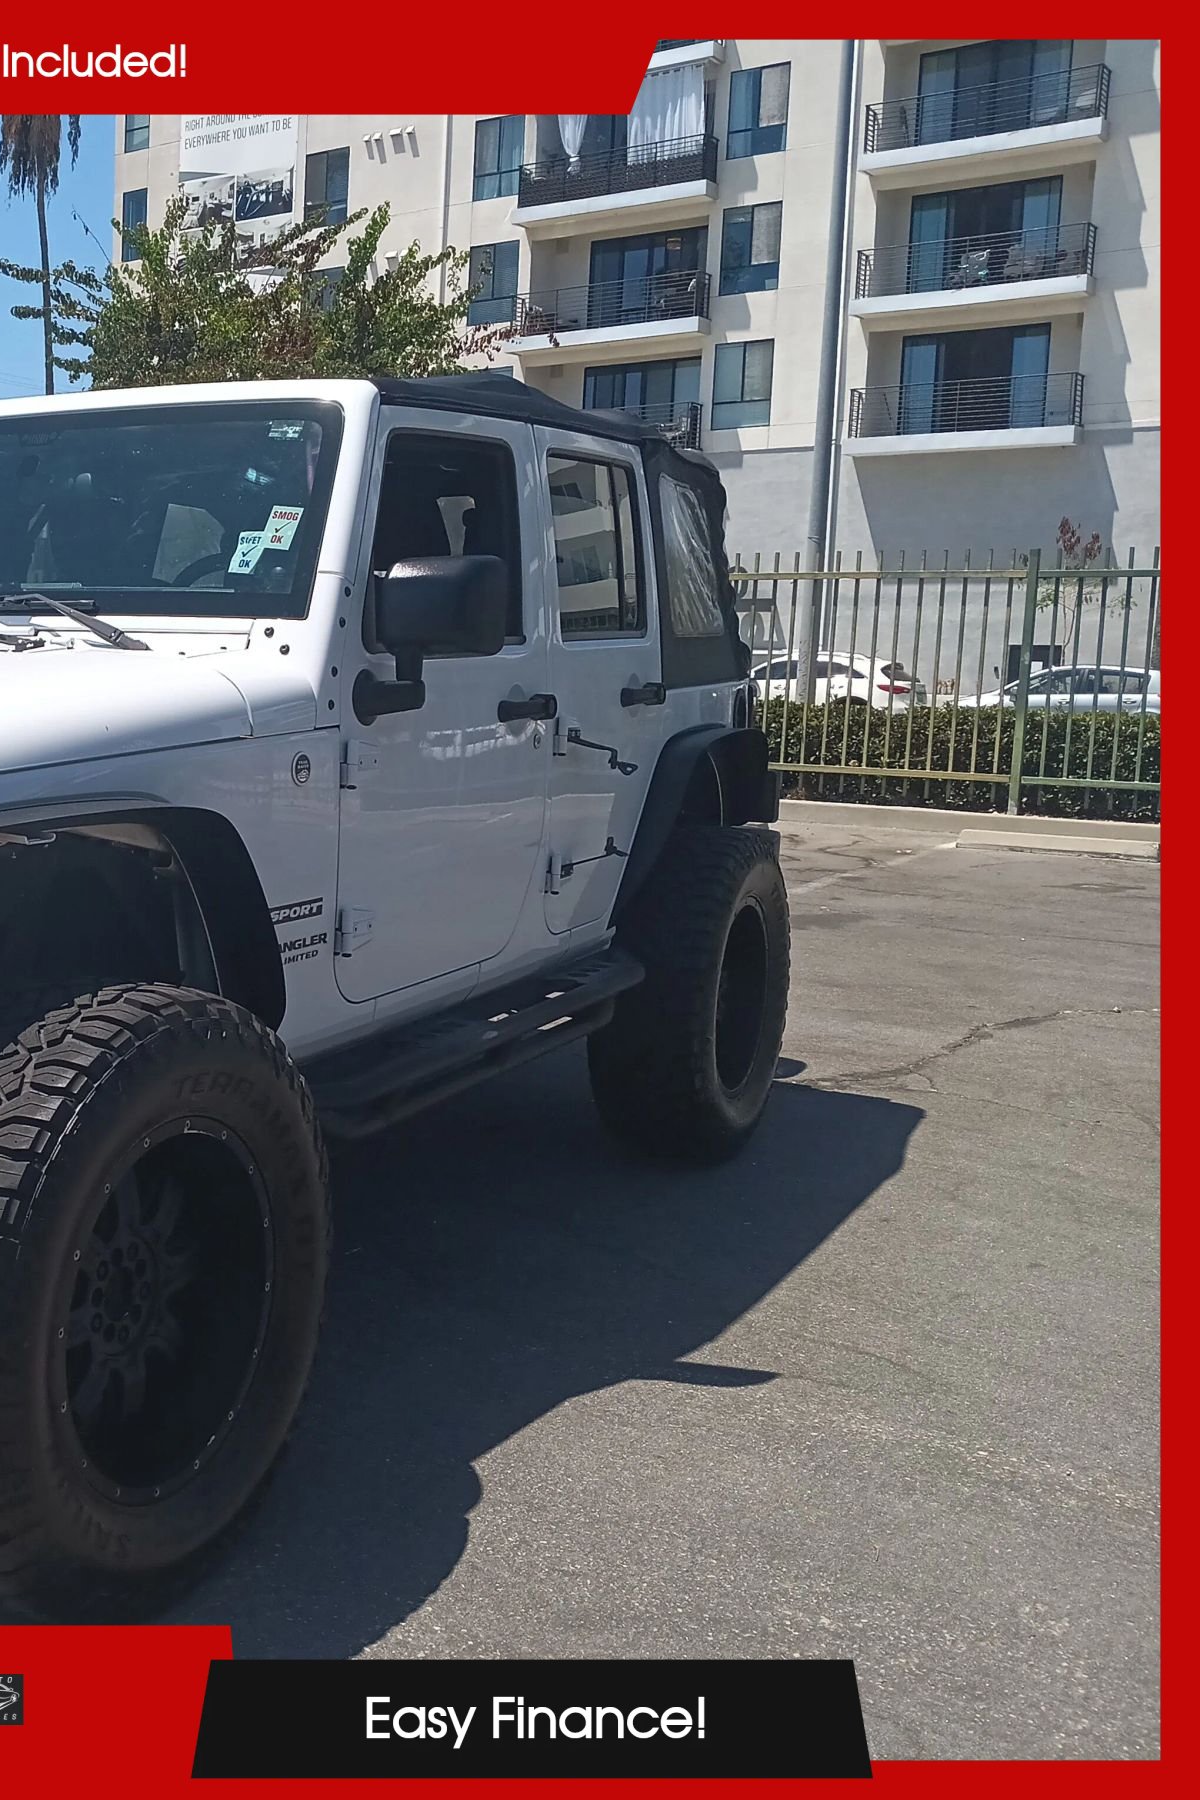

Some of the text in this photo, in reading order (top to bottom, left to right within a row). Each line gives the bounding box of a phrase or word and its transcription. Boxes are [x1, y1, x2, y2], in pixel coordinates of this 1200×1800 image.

[184, 117, 204, 132] RIGHT
[206, 114, 236, 128] AROUND
[184, 117, 292, 150] EVERYWHERE YOU WANT TO BE
[272, 510, 300, 521] SMOG
[270, 534, 284, 544] OK
[238, 559, 252, 568] OK
[270, 902, 323, 922] SPORT
[283, 950, 318, 965] IMITED
